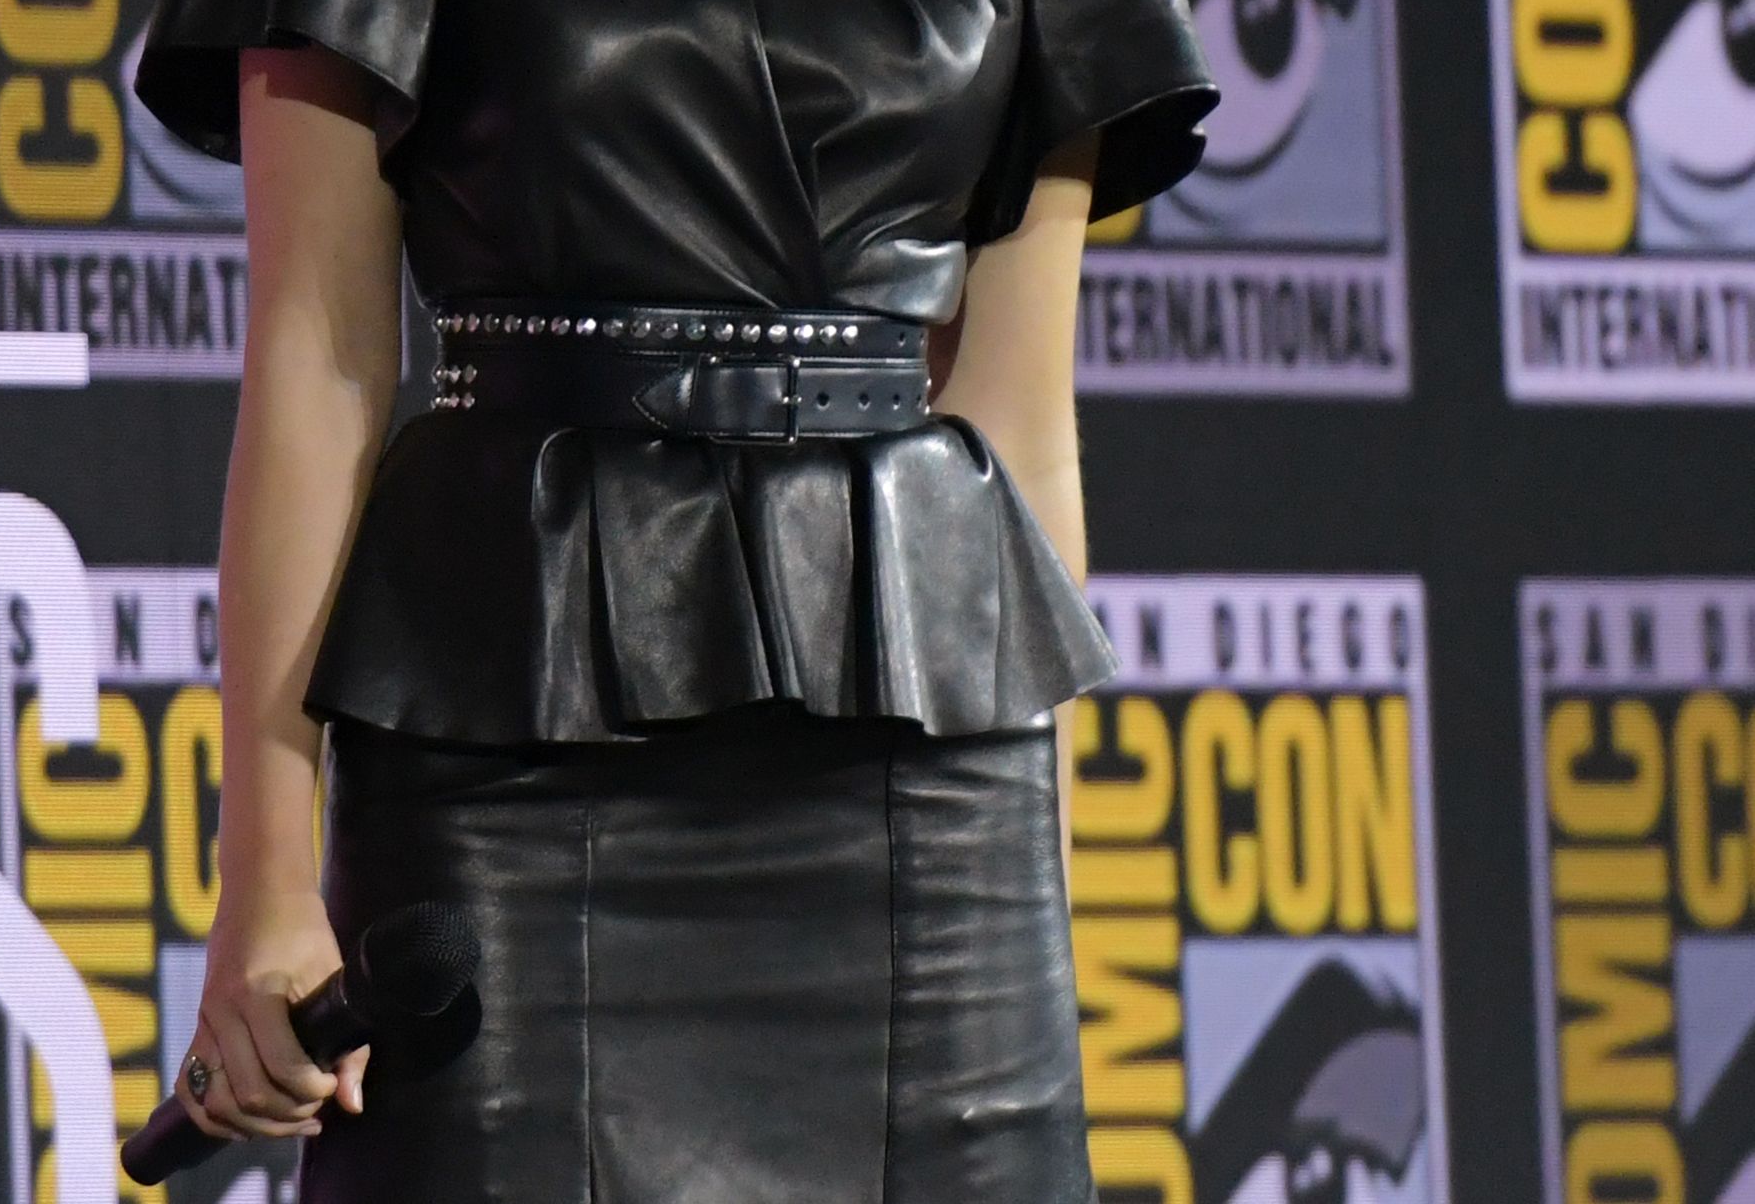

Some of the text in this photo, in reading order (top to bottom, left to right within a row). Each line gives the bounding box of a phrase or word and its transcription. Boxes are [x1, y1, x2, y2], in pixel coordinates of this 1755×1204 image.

[1080, 274, 1394, 372] TERNATIONAL
[9, 598, 141, 666] SN
[1212, 599, 1410, 674] DIEGO
[1538, 601, 1656, 674] SAN
[1181, 688, 1418, 935] CON
[1546, 699, 1686, 1204] OMIC
